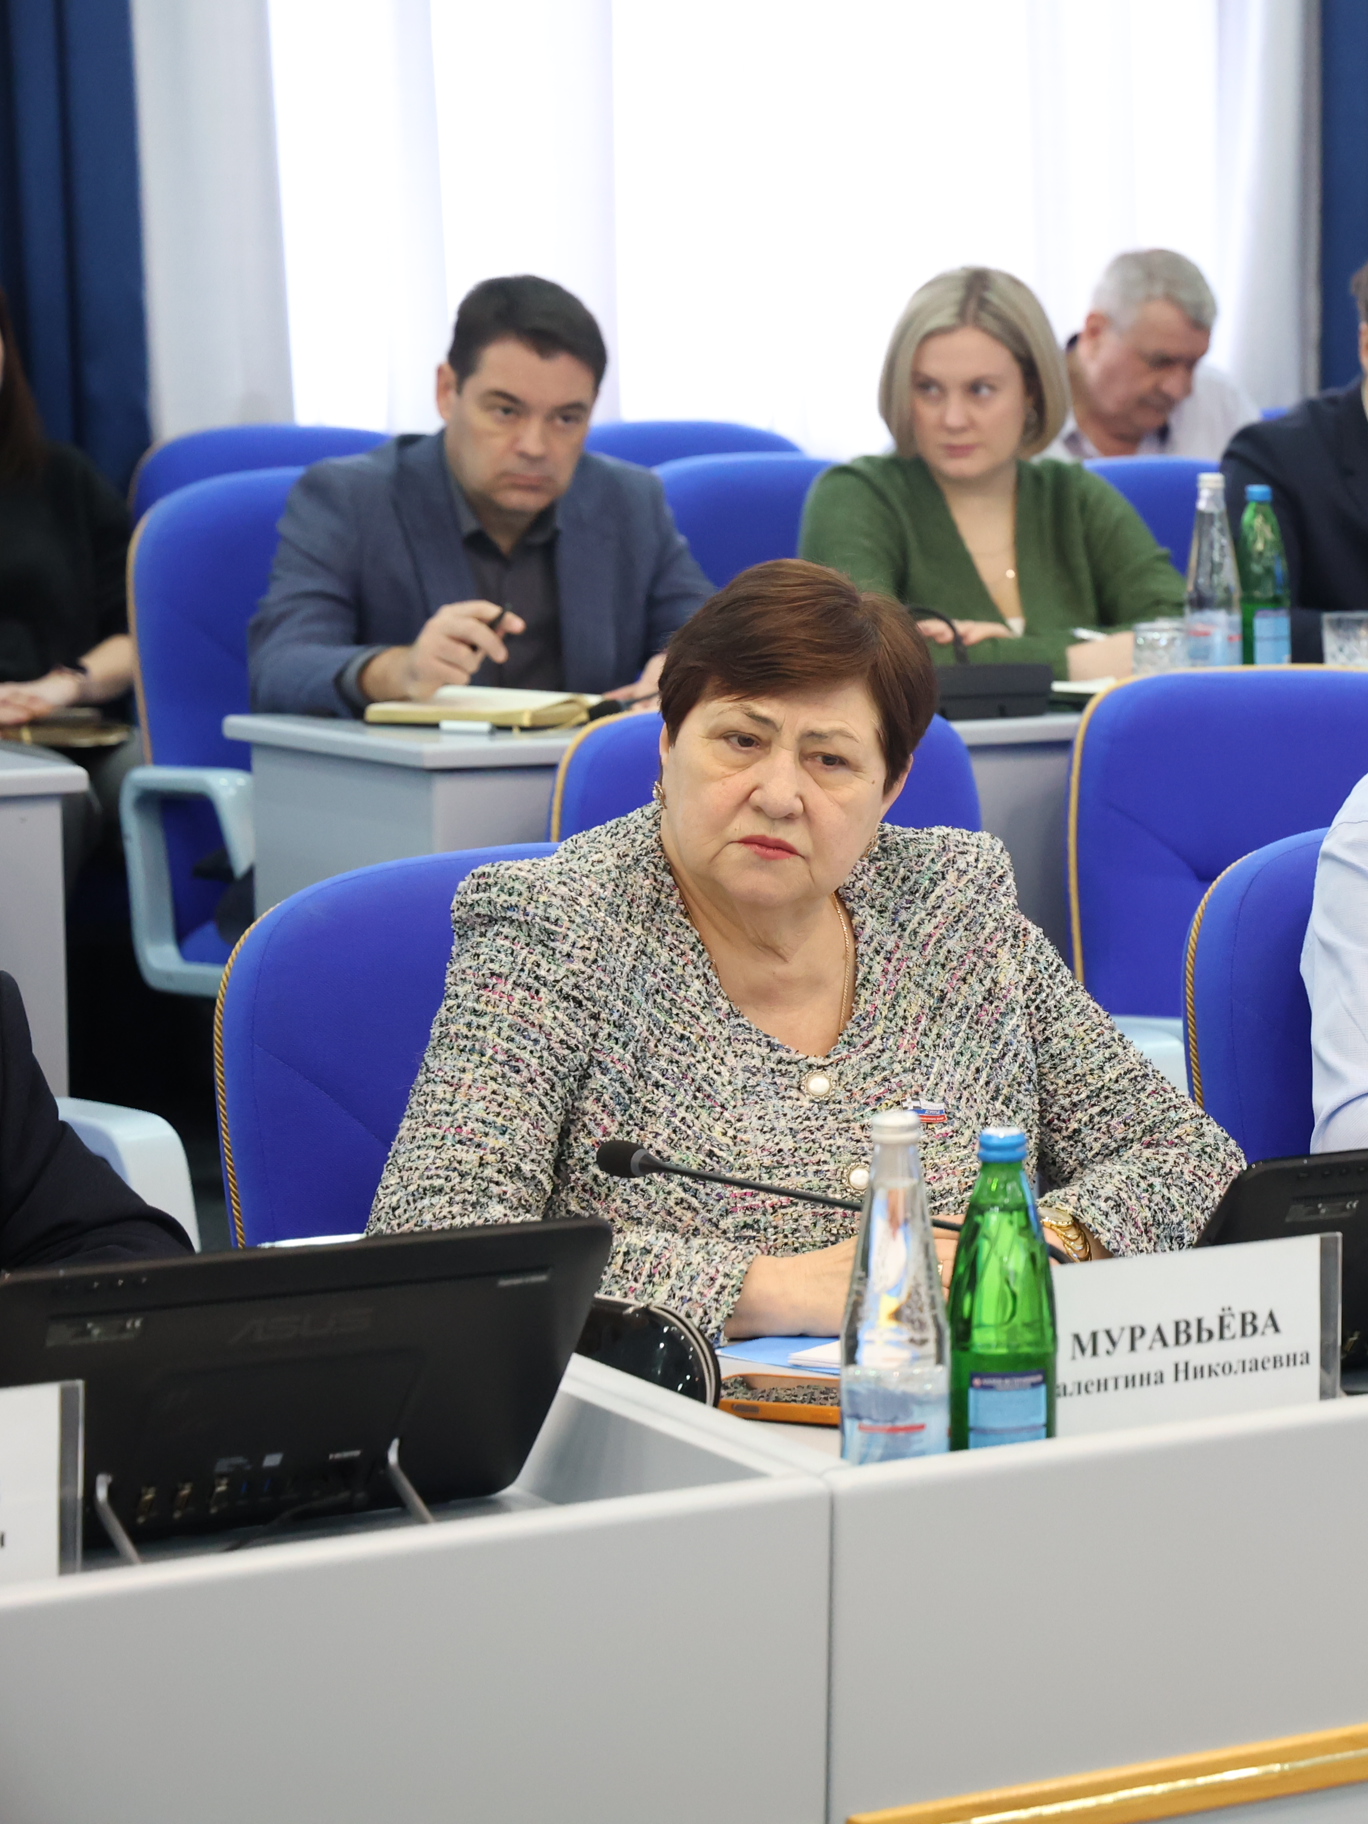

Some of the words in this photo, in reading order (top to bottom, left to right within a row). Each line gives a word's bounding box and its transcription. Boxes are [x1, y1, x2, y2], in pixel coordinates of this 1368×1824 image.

[227, 1306, 374, 1346] ASUS
[1070, 1305, 1282, 1361] МУРАВЬЁВА
[1055, 1370, 1165, 1399] алентина
[1173, 1350, 1311, 1384] Николаевна
